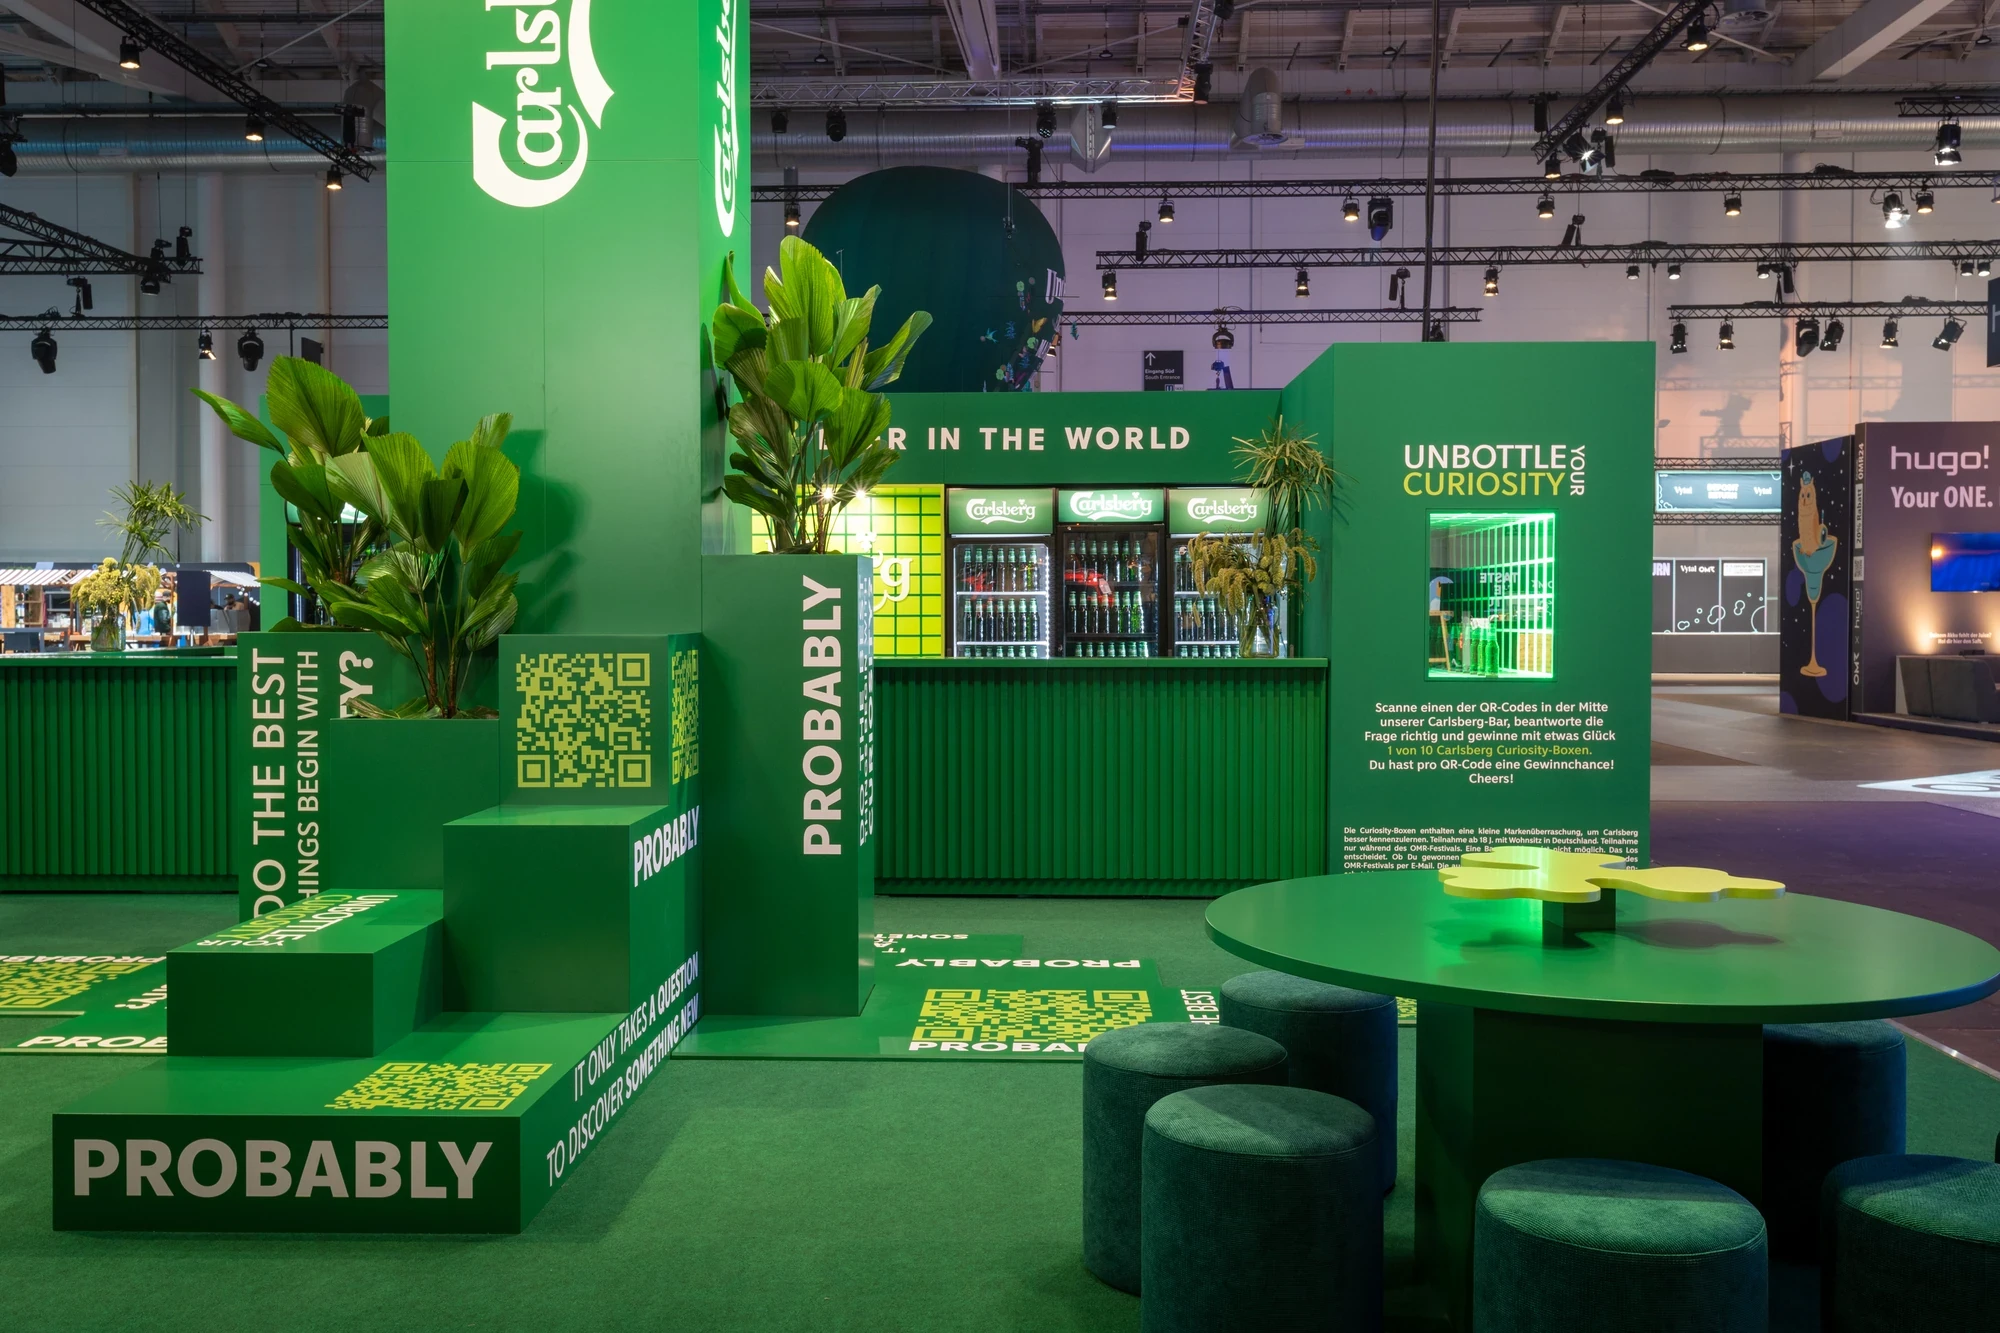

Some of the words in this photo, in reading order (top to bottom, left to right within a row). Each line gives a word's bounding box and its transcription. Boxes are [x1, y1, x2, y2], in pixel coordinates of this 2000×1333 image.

[472, 0, 614, 207] Carls
[928, 427, 960, 450] IN
[979, 427, 1045, 451] THE
[1064, 426, 1190, 451] WORLD
[1404, 444, 1567, 469] UNBOTTLE
[1891, 445, 1989, 476] hugo!
[1403, 471, 1566, 496] CURIOSITY
[1570, 445, 1586, 496] YOUR
[1069, 491, 1153, 522] Carlsberg
[1891, 486, 1939, 508] Your
[1944, 486, 1994, 508] ONE.
[966, 497, 1036, 525] Carlsberg
[1187, 497, 1258, 525] Carlsberg
[1680, 565, 1697, 574] Vytal
[252, 648, 285, 748] BEST
[297, 651, 318, 721] WITH
[802, 574, 842, 855] PROBABLY
[1375, 702, 1417, 713] Scanne
[1420, 702, 1453, 712] einen
[1456, 702, 1476, 712] der
[1479, 702, 1538, 713] QR-Codes
[1541, 702, 1552, 712] in
[1555, 702, 1575, 712] der
[1578, 702, 1608, 712] Mitte
[1380, 718, 1425, 727] unserer
[1428, 717, 1511, 729] Carlsberg-Bar,
[1514, 717, 1582, 727] beantworte
[1585, 716, 1604, 727] die
[1364, 731, 1397, 743] Frage
[1400, 731, 1438, 743] richtig
[1441, 731, 1465, 741] und
[1468, 731, 1518, 743] gewinne
[1521, 730, 1541, 741] mit
[1544, 732, 1579, 741] etwas
[1582, 730, 1616, 741] Glück
[1387, 746, 1393, 755] 1
[1420, 746, 1433, 755] 10
[1436, 745, 1493, 758] Carlsberg
[1496, 745, 1592, 758] Curiosity-Boxen.
[297, 730, 318, 811] BEGIN
[1369, 760, 1385, 770] Du
[1388, 759, 1414, 770] hast
[1417, 762, 1437, 773] pro
[1440, 760, 1492, 770] QR-Code
[1495, 760, 1521, 769] eine
[1524, 759, 1614, 770] Gewinnchance!
[1469, 773, 1514, 784] Cheers!
[253, 765, 285, 845] THE
[1360, 827, 1416, 836] Curiosity-Boxen
[1420, 827, 1455, 835] enthalten
[1504, 828, 1583, 837] Markenüberraschung,
[1603, 829, 1639, 838] Carlsberg
[1430, 836, 1467, 844] Teilnahme
[298, 821, 319, 898] HINGS
[633, 805, 699, 888] PROBABLY
[1394, 844, 1407, 852] des
[1574, 846, 1606, 854] möglich.
[253, 859, 286, 918] DO
[217, 895, 352, 939] CURIOSITY
[257, 895, 398, 940] UNBOTTLE
[0, 955, 167, 963] PROBAB
[895, 958, 1141, 968] PROBABLY
[1180, 989, 1219, 1012] BEST
[574, 1059, 585, 1101] IT
[588, 1035, 617, 1087] ONLY
[619, 1005, 648, 1055] TAKES
[649, 994, 656, 1023] A
[658, 951, 698, 1015] QUESTION
[17, 1036, 167, 1047] PROB
[908, 1042, 1087, 1052] PROBA
[547, 1140, 565, 1187] TO
[569, 1077, 624, 1165] DISCOVER
[625, 1022, 680, 1099] SOMETHING
[680, 992, 699, 1036] NEW
[73, 1138, 494, 1199] PROBABLY
